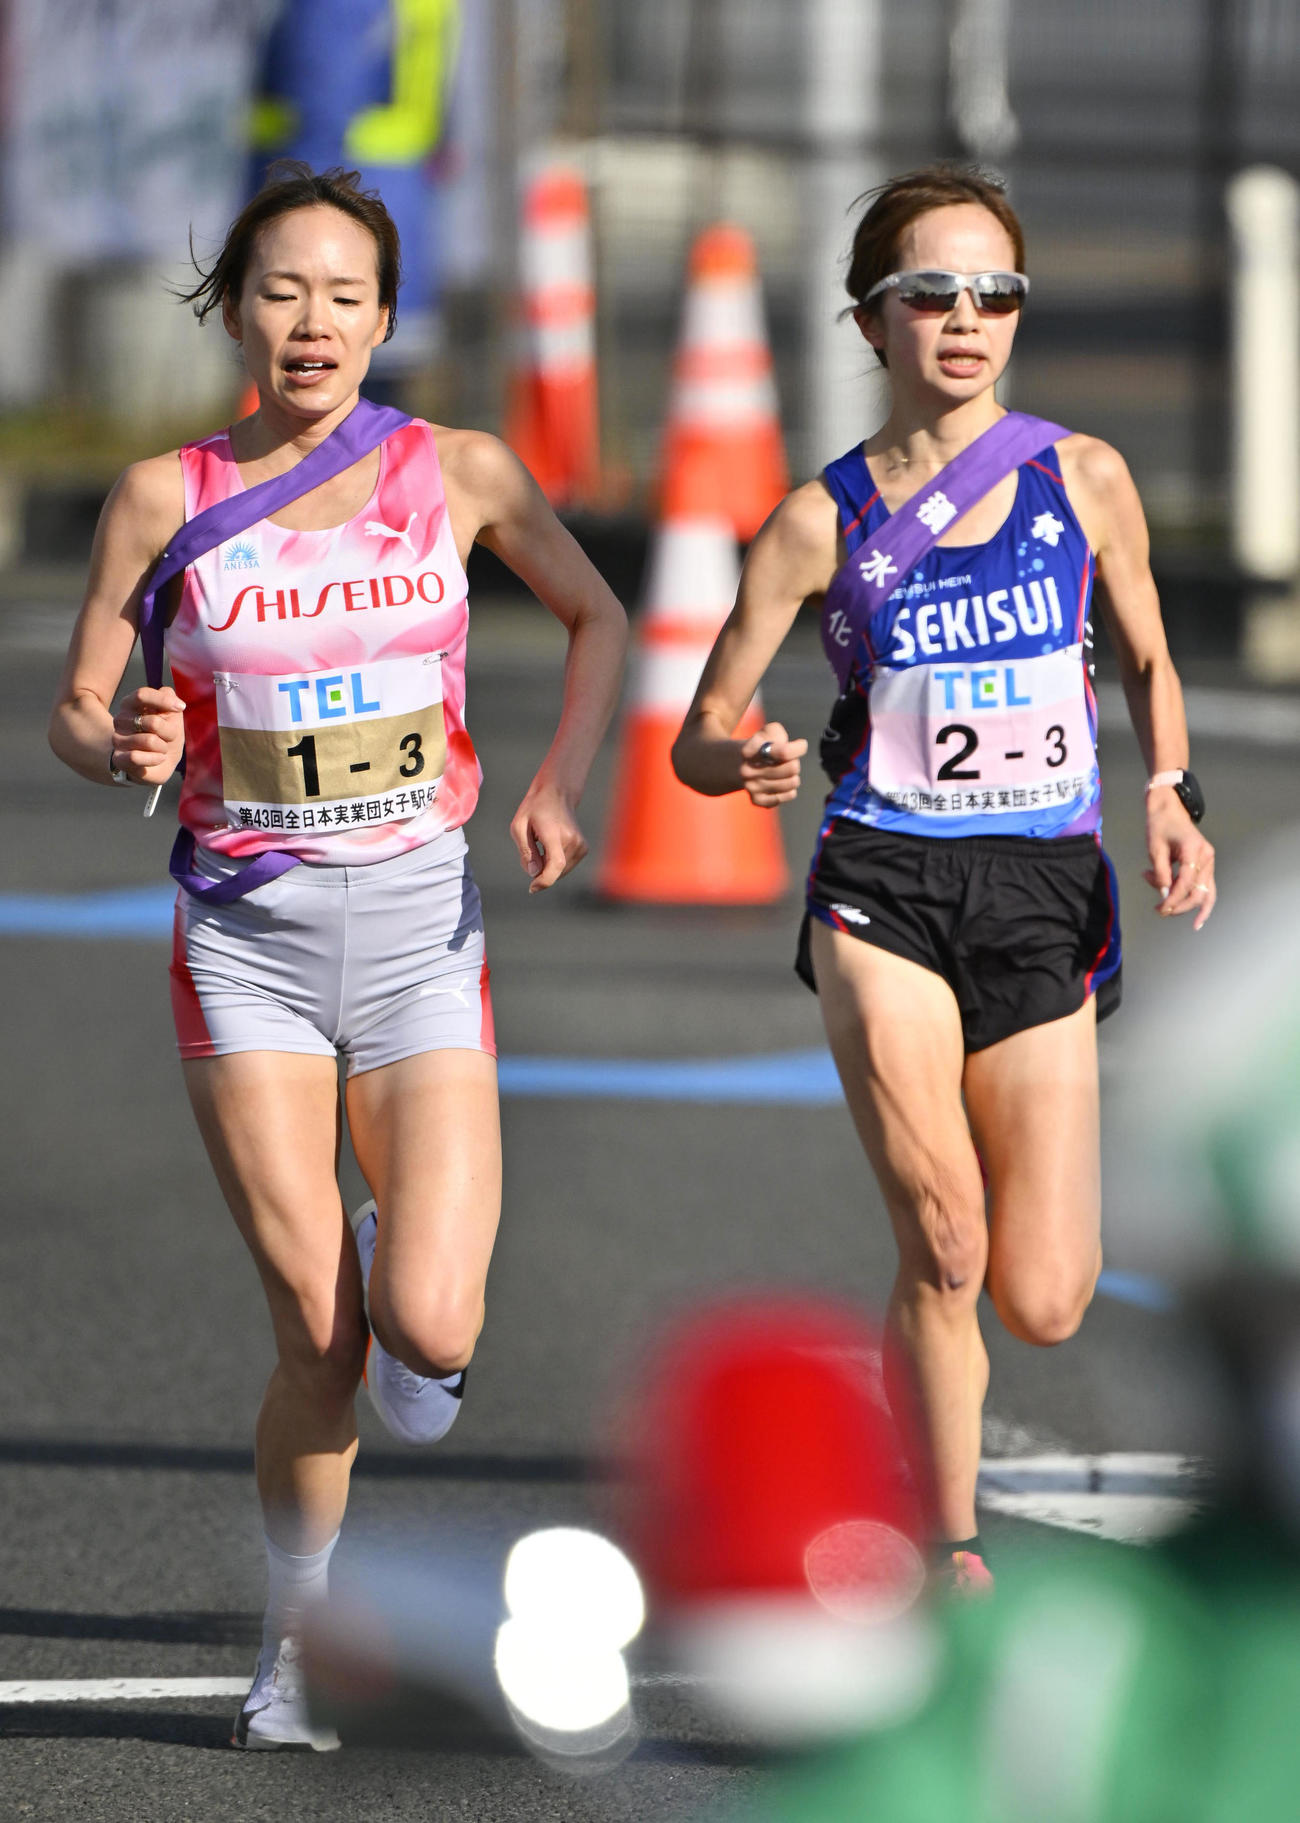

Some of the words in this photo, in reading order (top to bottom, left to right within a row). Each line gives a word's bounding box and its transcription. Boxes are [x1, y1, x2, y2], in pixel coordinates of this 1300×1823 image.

[224, 559, 261, 571] ANESSA
[938, 574, 972, 590] HEIM
[208, 571, 445, 632] SHISEIDO
[891, 576, 1064, 662] SEKISUI
[278, 672, 381, 723] TEL
[934, 667, 1032, 711] TEL
[287, 735, 321, 797] 1
[399, 732, 425, 778] 3
[935, 723, 981, 781] 2
[1045, 724, 1068, 768] 3
